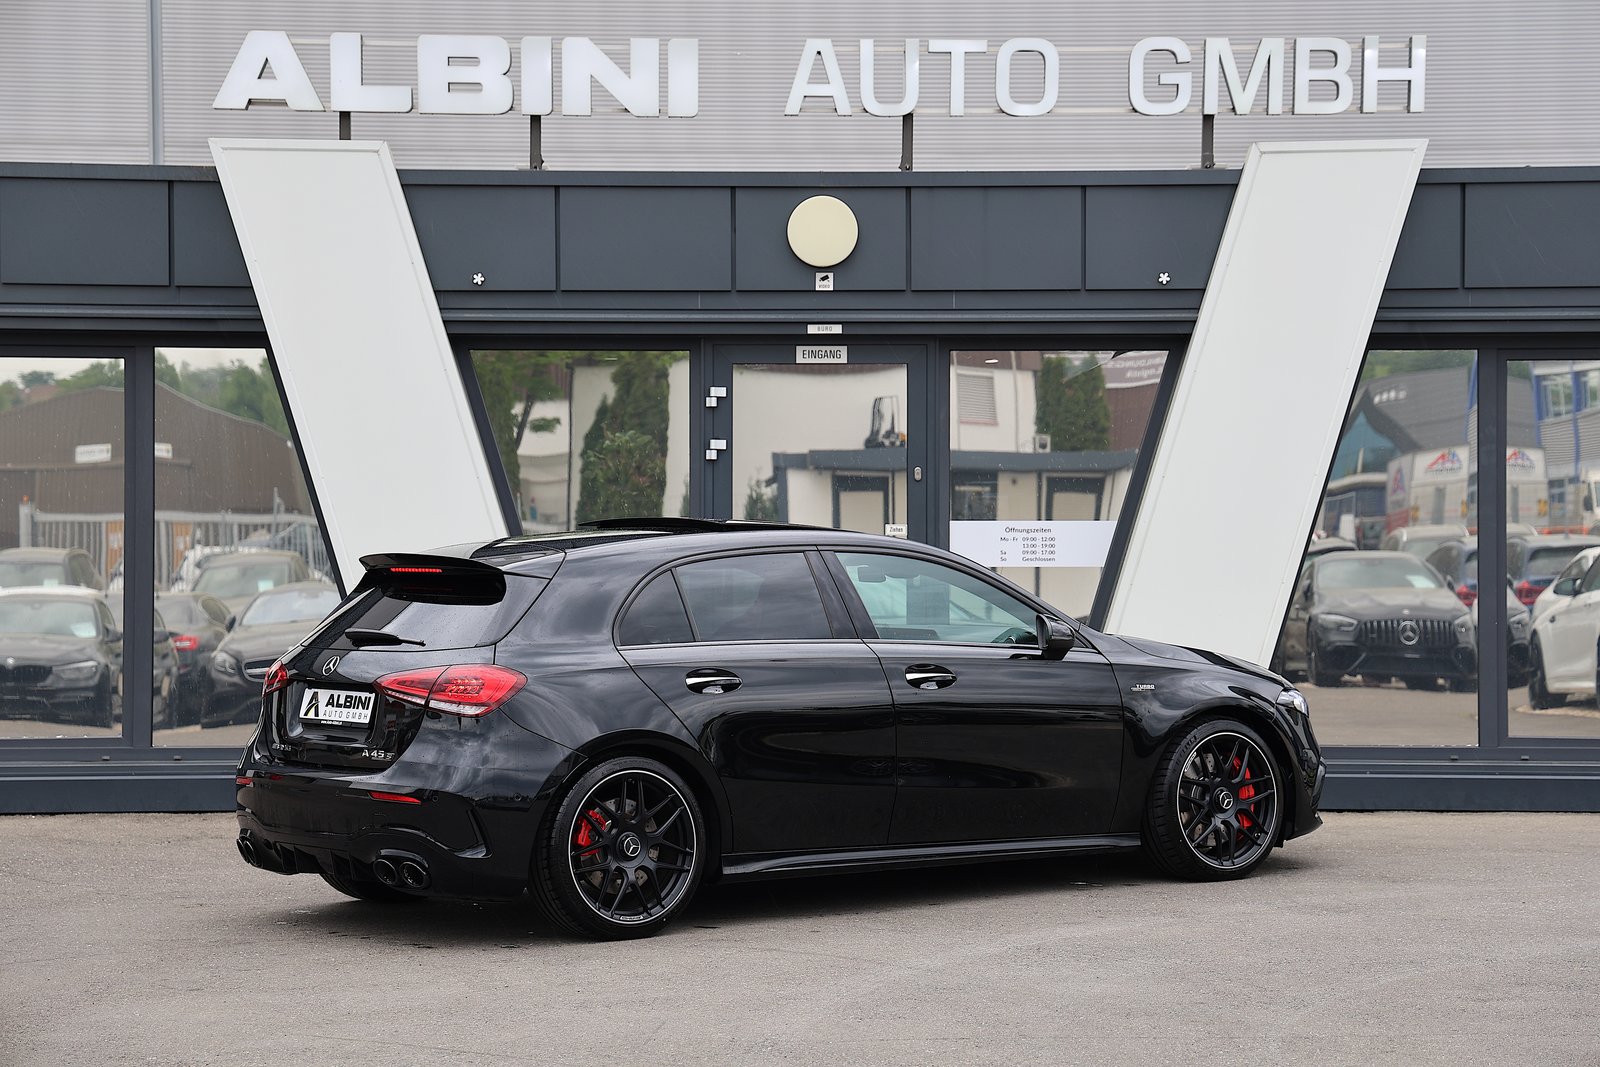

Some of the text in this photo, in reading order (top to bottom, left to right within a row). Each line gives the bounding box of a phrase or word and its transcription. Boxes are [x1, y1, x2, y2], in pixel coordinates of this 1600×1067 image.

[212, 30, 1427, 118] ALBINI AUTO GMBH
[802, 349, 842, 359] EINGANG
[1004, 525, 1052, 534] Öffnungszeiten
[325, 693, 372, 710] ALBINI
[322, 709, 369, 720] AUTO GMBH
